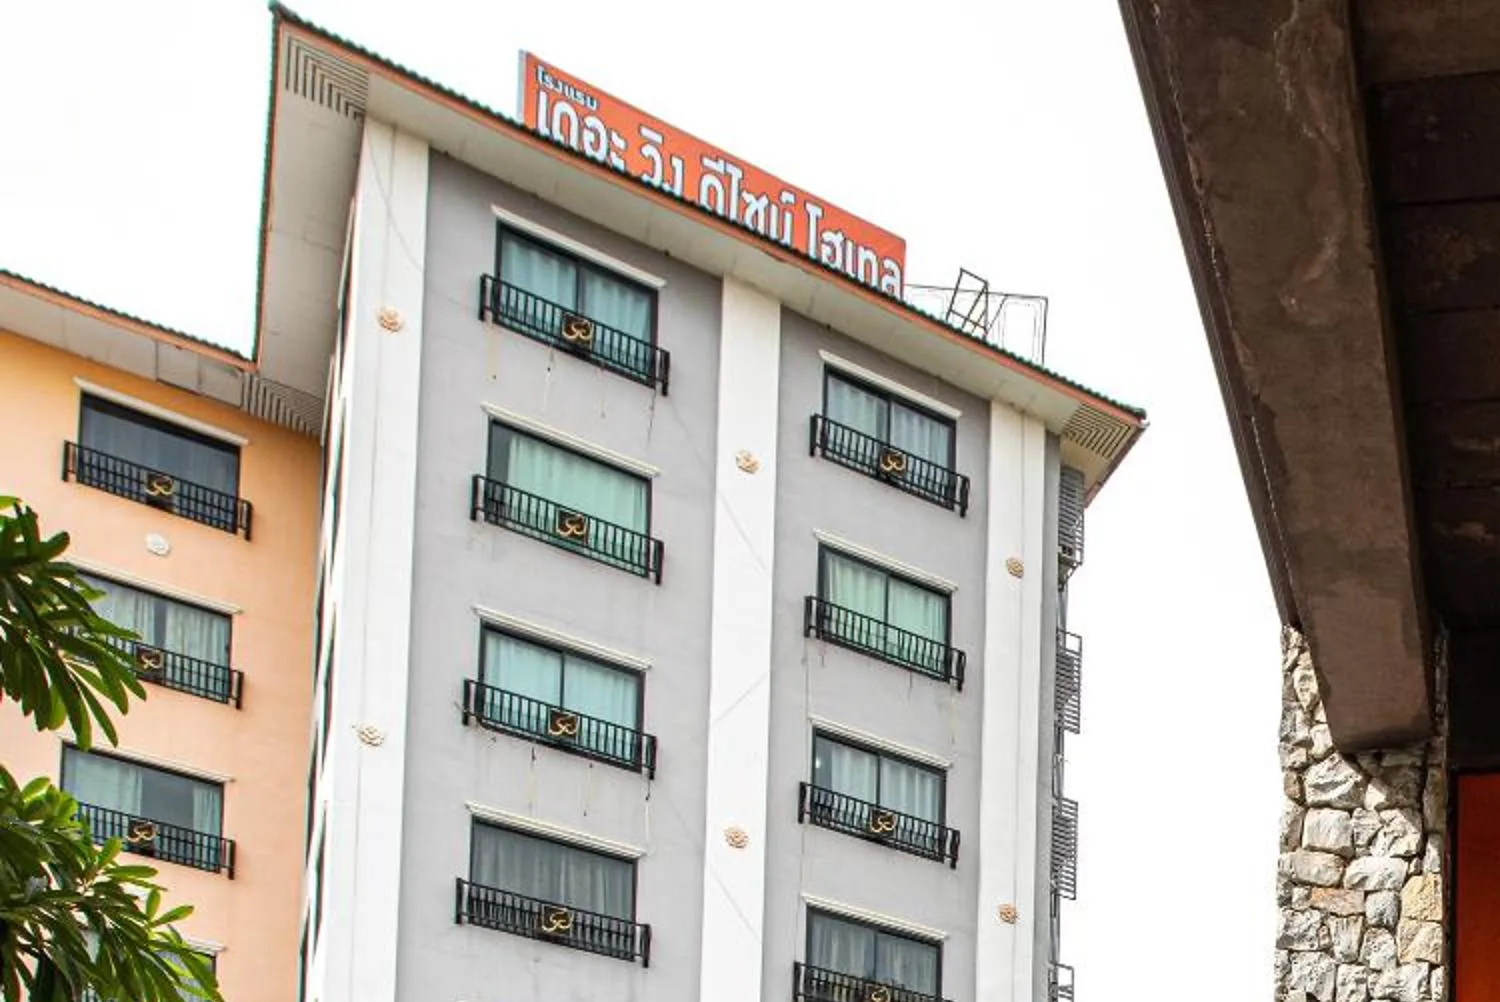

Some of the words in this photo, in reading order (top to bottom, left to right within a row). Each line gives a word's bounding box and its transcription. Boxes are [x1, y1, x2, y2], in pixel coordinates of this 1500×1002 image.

[535, 64, 599, 111] โรงแรม
[536, 91, 628, 172] เดอะ
[638, 124, 684, 197] วิง
[699, 155, 796, 246] ดีไซน์
[803, 201, 904, 300] โฮเทล
